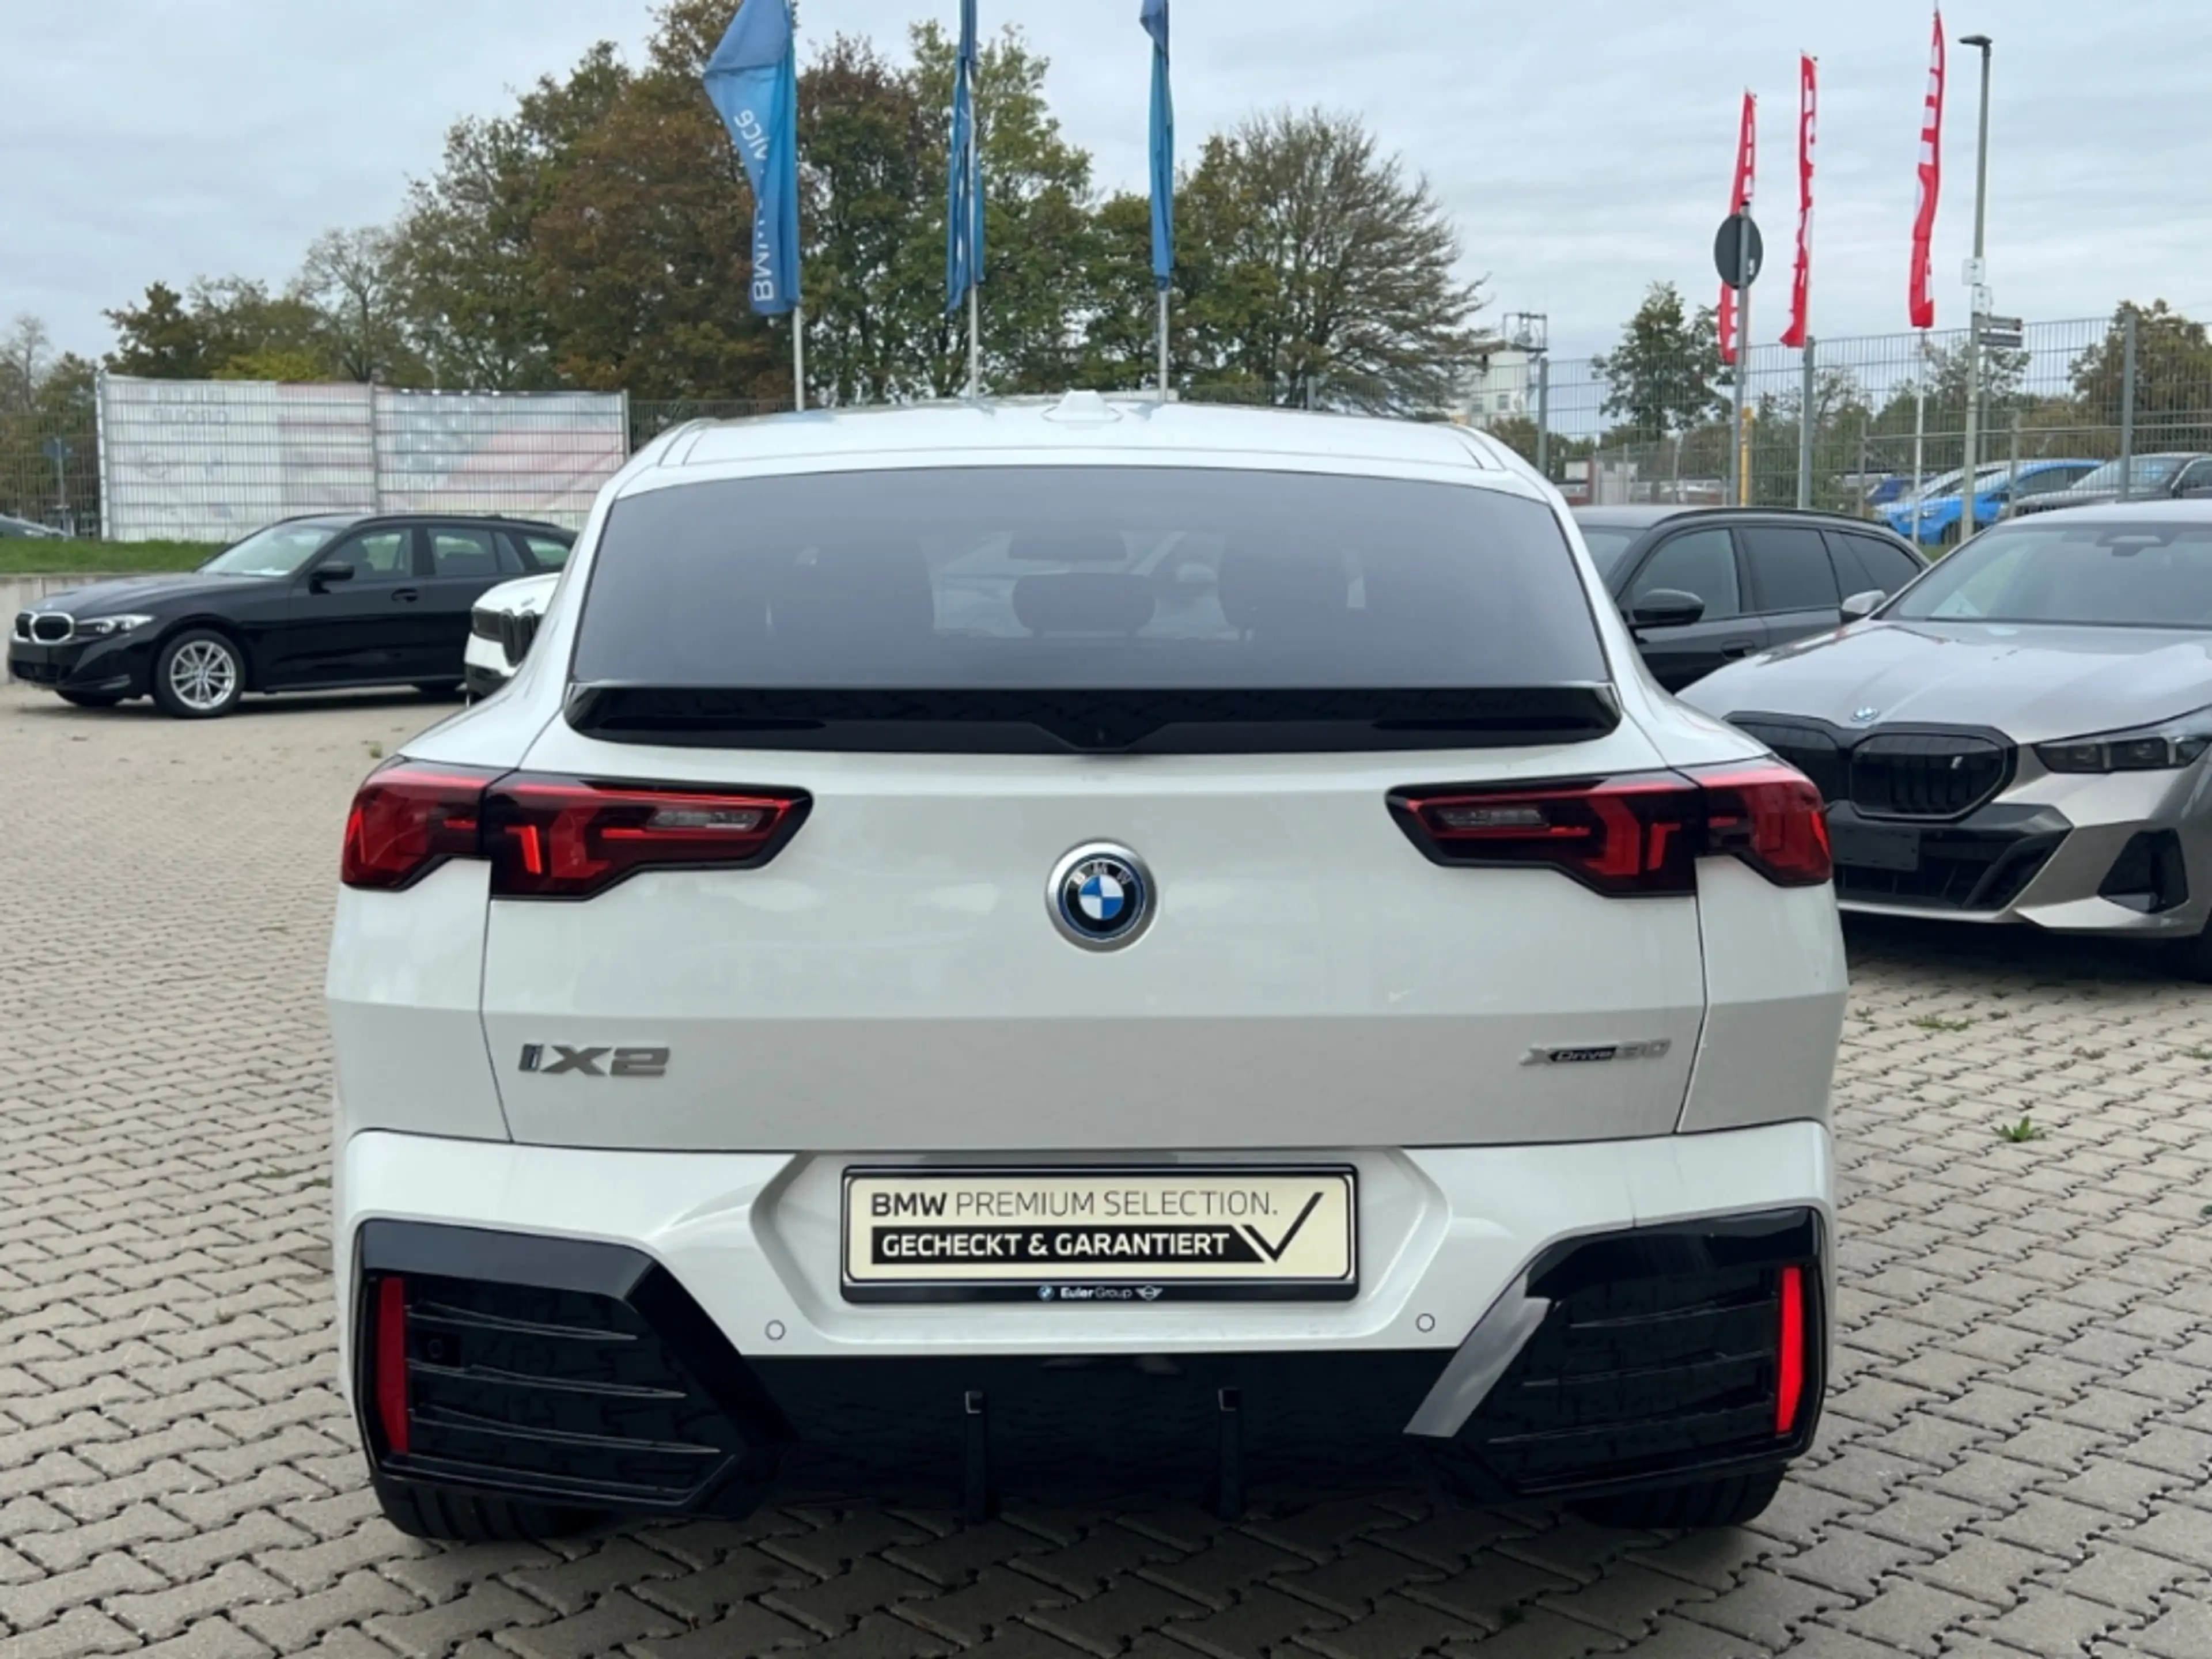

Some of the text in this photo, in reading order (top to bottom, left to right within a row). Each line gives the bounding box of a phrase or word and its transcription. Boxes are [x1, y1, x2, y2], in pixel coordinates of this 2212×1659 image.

[871, 1190, 1278, 1217] BMW PREMIUM SELECTION.
[882, 1232, 1230, 1256] GECHECKT & GARANTIERT
